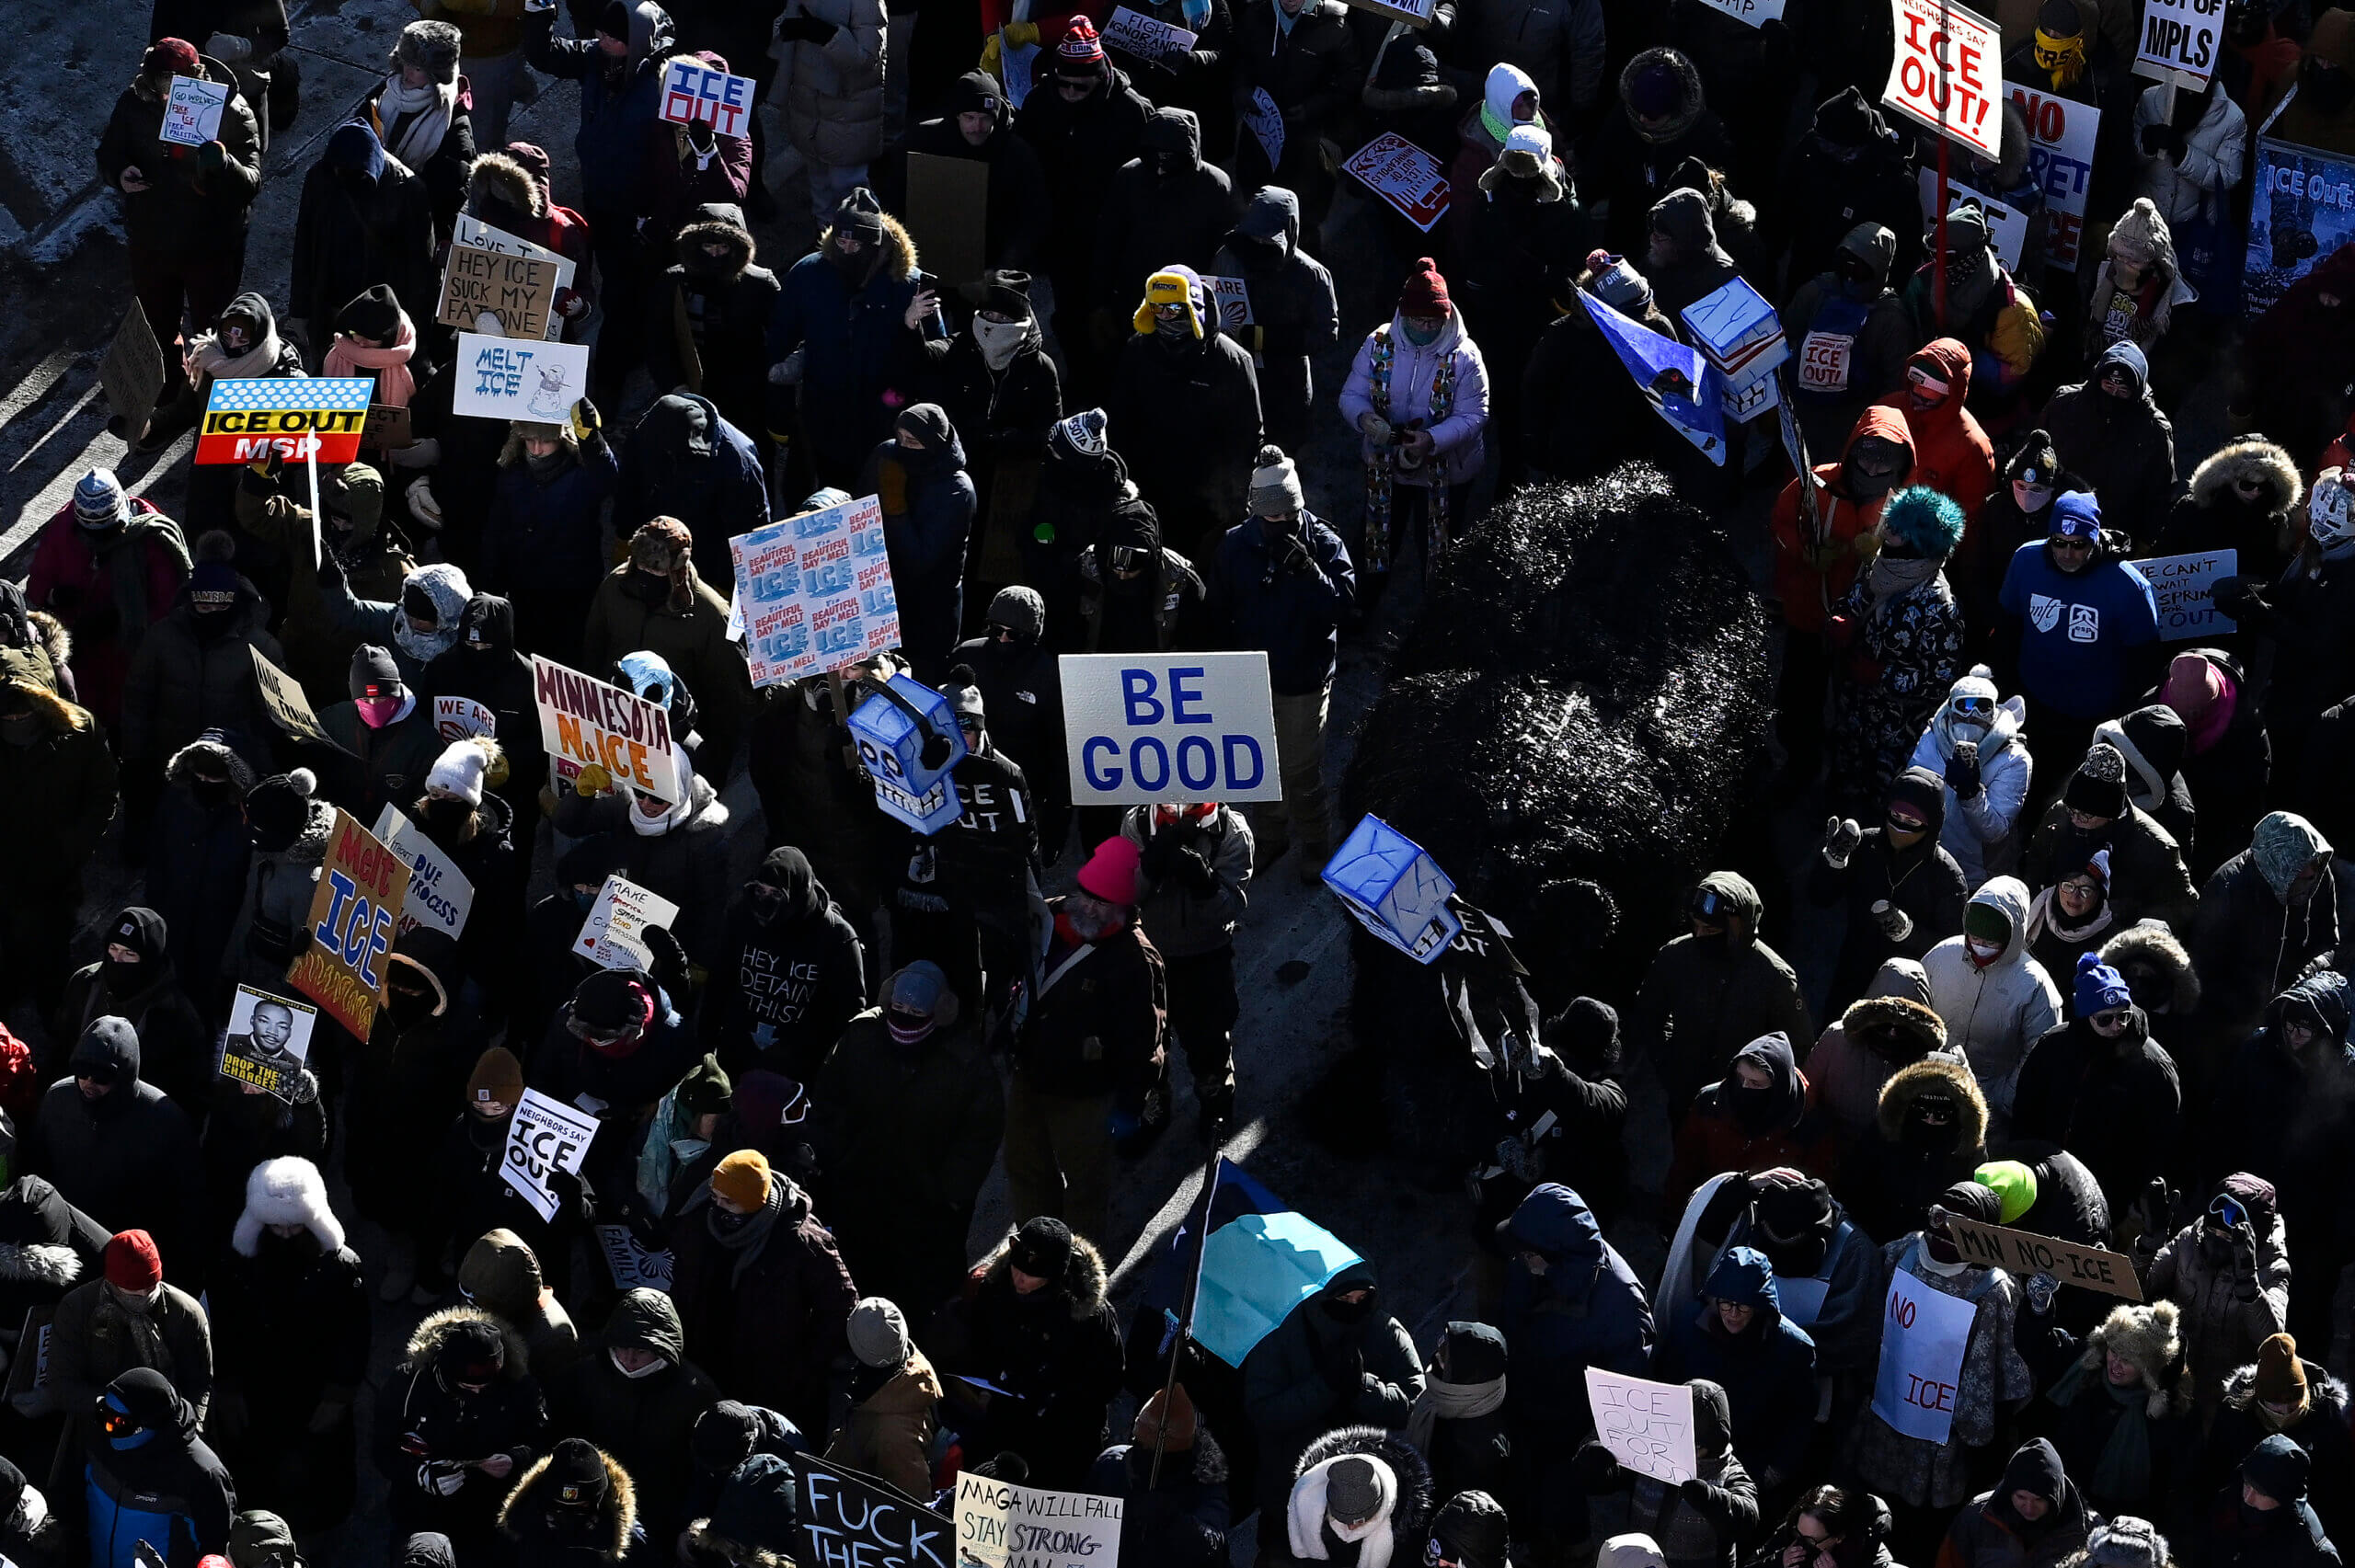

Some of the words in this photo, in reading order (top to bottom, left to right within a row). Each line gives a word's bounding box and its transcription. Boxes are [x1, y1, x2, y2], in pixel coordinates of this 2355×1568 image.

[1109, 20, 1187, 52] IGNORANCE
[1128, 15, 1178, 40] FIGHT
[2145, 15, 2213, 68] MPLS
[1903, 11, 1983, 91] ICE
[671, 63, 744, 107] ICE
[1901, 55, 1991, 136] OUT!
[665, 92, 743, 134] OUT
[2013, 88, 2066, 143] NO
[2266, 164, 2305, 198] ICE
[2307, 175, 2353, 212] Out
[458, 252, 500, 280] HEY
[505, 258, 541, 287] ICE
[451, 277, 492, 303] SUCK
[501, 288, 537, 310] MY
[1215, 280, 1245, 295] ARE
[476, 348, 534, 373] MELT
[1806, 347, 1841, 369] ICE
[476, 370, 522, 397] ICE
[1804, 365, 1841, 385] OUT!
[206, 411, 271, 433] ICE
[279, 411, 363, 432] OUT
[234, 437, 322, 459] MSP
[850, 521, 867, 533] DAY
[750, 544, 796, 568] BEAUTIFUL
[751, 563, 765, 577] DAY
[774, 550, 797, 567] MELT
[802, 538, 849, 562] BEAUTIFUL
[802, 556, 820, 571] DAY
[827, 547, 850, 562] MELT
[752, 562, 801, 598] ICE
[804, 555, 854, 596] ICE
[859, 577, 877, 591] DAY
[2154, 578, 2189, 590] WAIT
[2163, 558, 2217, 577] CAN'T
[812, 597, 859, 623] BEAUTIFUL
[2158, 589, 2212, 606] SPRIN
[754, 603, 803, 629] BEAUTIFUL
[756, 624, 774, 638] DAY
[781, 612, 805, 630] MELT
[813, 618, 830, 632] DAY
[837, 606, 860, 622] MELT
[2170, 609, 2215, 627] OUT
[758, 623, 809, 657] ICE
[814, 616, 864, 654] ICE
[869, 635, 886, 649] DAY
[826, 651, 867, 672] BEAUTIFU
[536, 662, 671, 756] MINNESOTA
[1120, 667, 1213, 726] BE
[439, 700, 465, 715] WE
[472, 706, 493, 732] ARE
[595, 727, 655, 790] ICE
[1082, 734, 1265, 792] GOOD
[957, 811, 1001, 832] UT
[337, 821, 396, 898] Melt
[414, 853, 442, 888] DUE
[411, 875, 458, 927] PROCESS
[608, 880, 648, 904] MAKE
[612, 915, 632, 930] KIND
[615, 909, 647, 926] SMART
[741, 943, 780, 972] HEY
[789, 959, 818, 981] ICE
[741, 967, 817, 1003] DETAIN
[743, 990, 806, 1024] THIS!
[223, 1063, 276, 1092] CHARGES
[224, 1053, 255, 1072] DROP
[258, 1066, 280, 1081] THE
[519, 1106, 569, 1136] NEIGHBORS
[570, 1131, 588, 1144] SAY
[511, 1119, 578, 1173] ICE
[509, 1145, 554, 1196] OU
[604, 1229, 641, 1285] FAMILY
[1959, 1230, 2005, 1264] MN
[2016, 1239, 2115, 1285] NO-ICE
[1890, 1291, 1916, 1329] NO
[1597, 1384, 1671, 1417] ICE
[1903, 1373, 1956, 1413] ICE
[1607, 1429, 1675, 1464] FOR
[960, 1479, 1020, 1512] MAGA
[1026, 1494, 1083, 1517] WILL
[1086, 1496, 1122, 1519] FALL
[808, 1472, 948, 1568] FUCK
[962, 1511, 1006, 1548] STAY
[1008, 1524, 1102, 1555] STRONG
